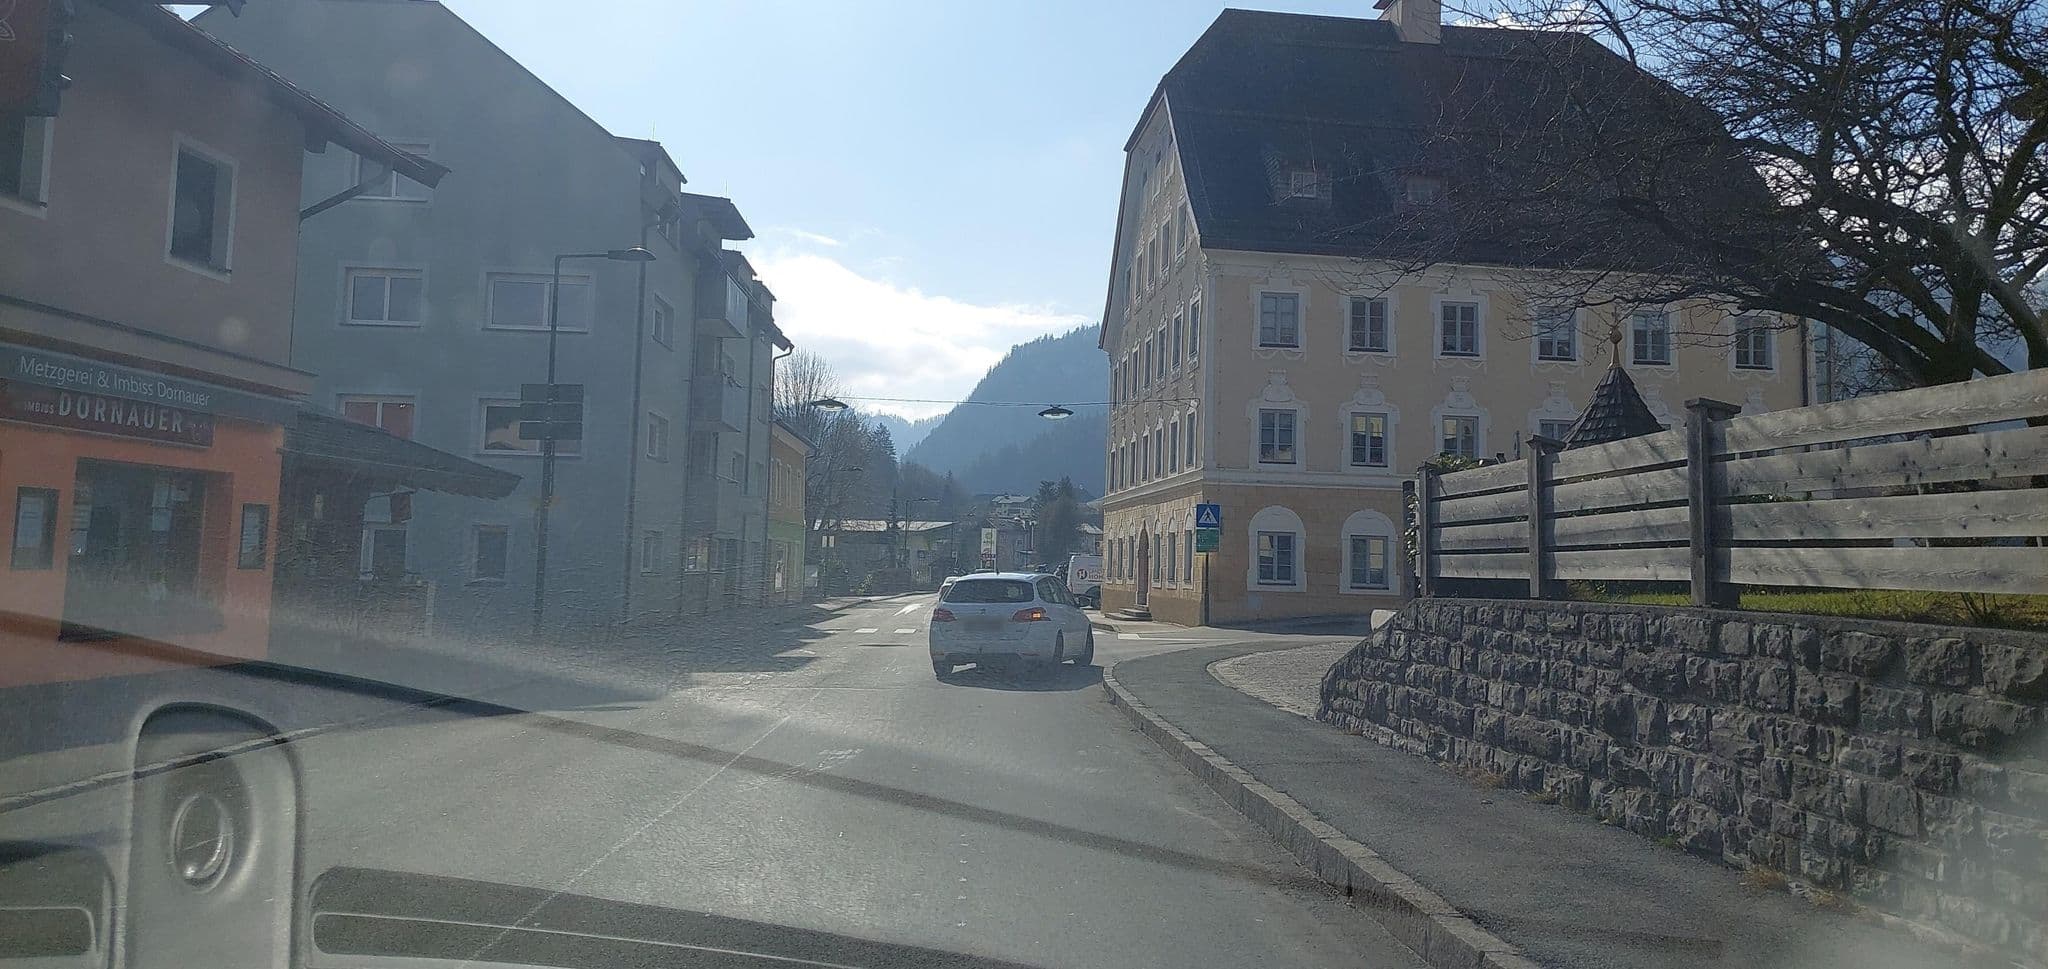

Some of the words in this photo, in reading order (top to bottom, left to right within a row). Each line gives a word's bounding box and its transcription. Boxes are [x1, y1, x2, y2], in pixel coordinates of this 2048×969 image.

[19, 355, 93, 386] Metzgerei
[97, 371, 110, 389] &
[114, 374, 153, 396] Imbiss
[157, 383, 210, 406] Dornauer
[59, 392, 182, 433] DORNAUER
